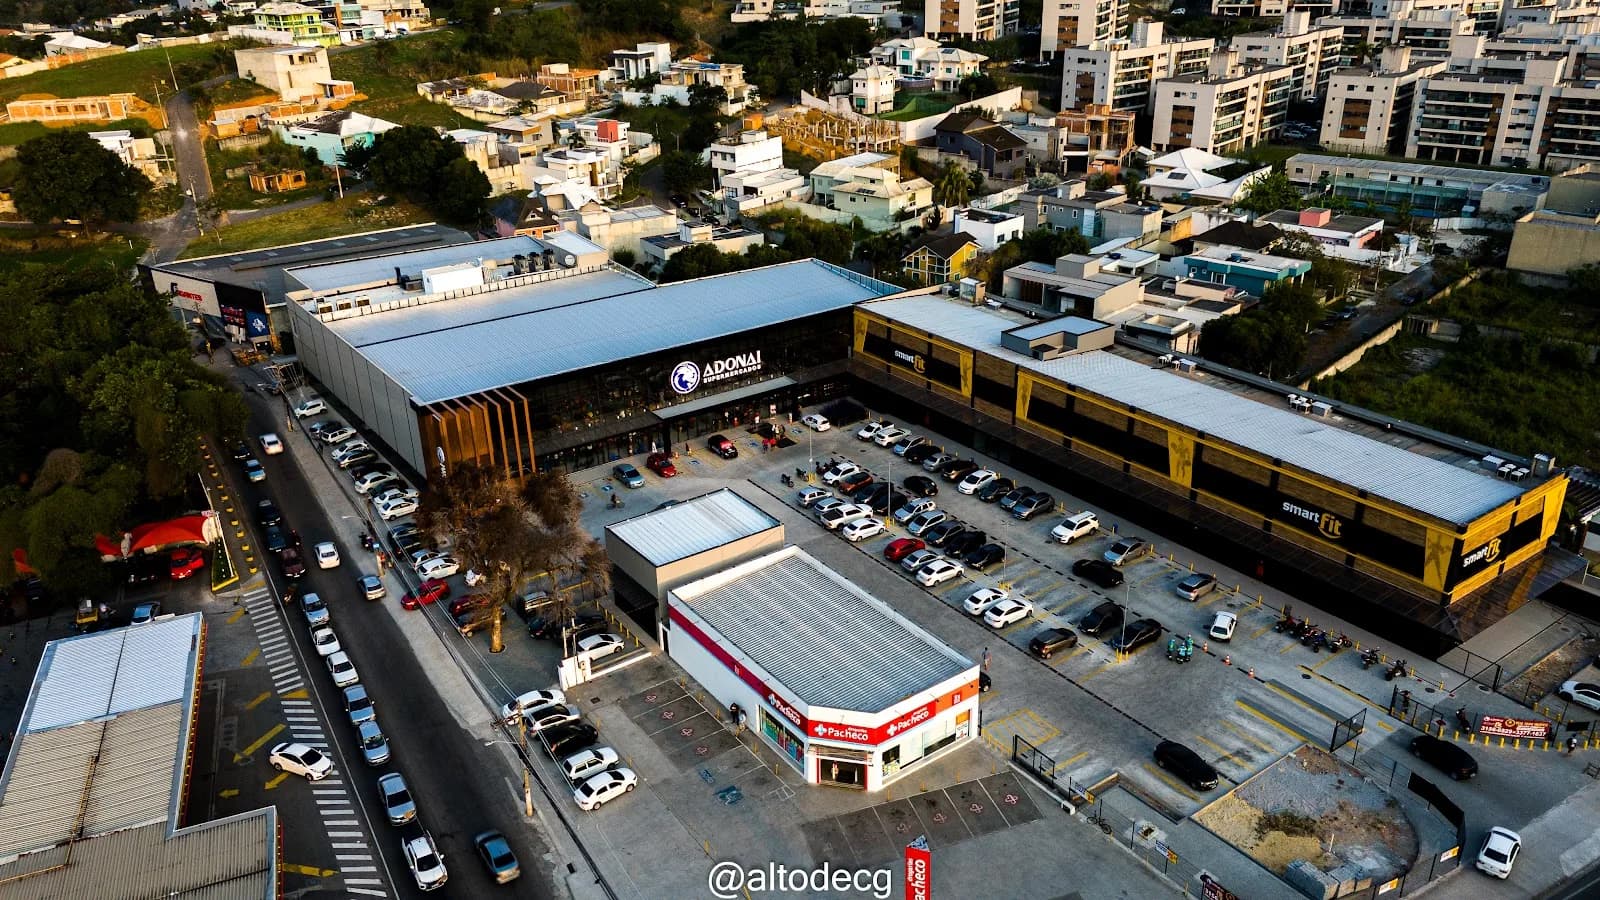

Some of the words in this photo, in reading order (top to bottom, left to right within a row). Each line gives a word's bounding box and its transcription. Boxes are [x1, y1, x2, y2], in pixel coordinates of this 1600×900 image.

[703, 350, 762, 377] ADONAI
[704, 364, 762, 383] SUPERMERCADOS
[1282, 502, 1320, 523] smart
[1319, 513, 1342, 536] fit
[897, 710, 929, 731] Pacheco
[827, 727, 869, 741] Pacheco
[911, 859, 926, 900] acheco
